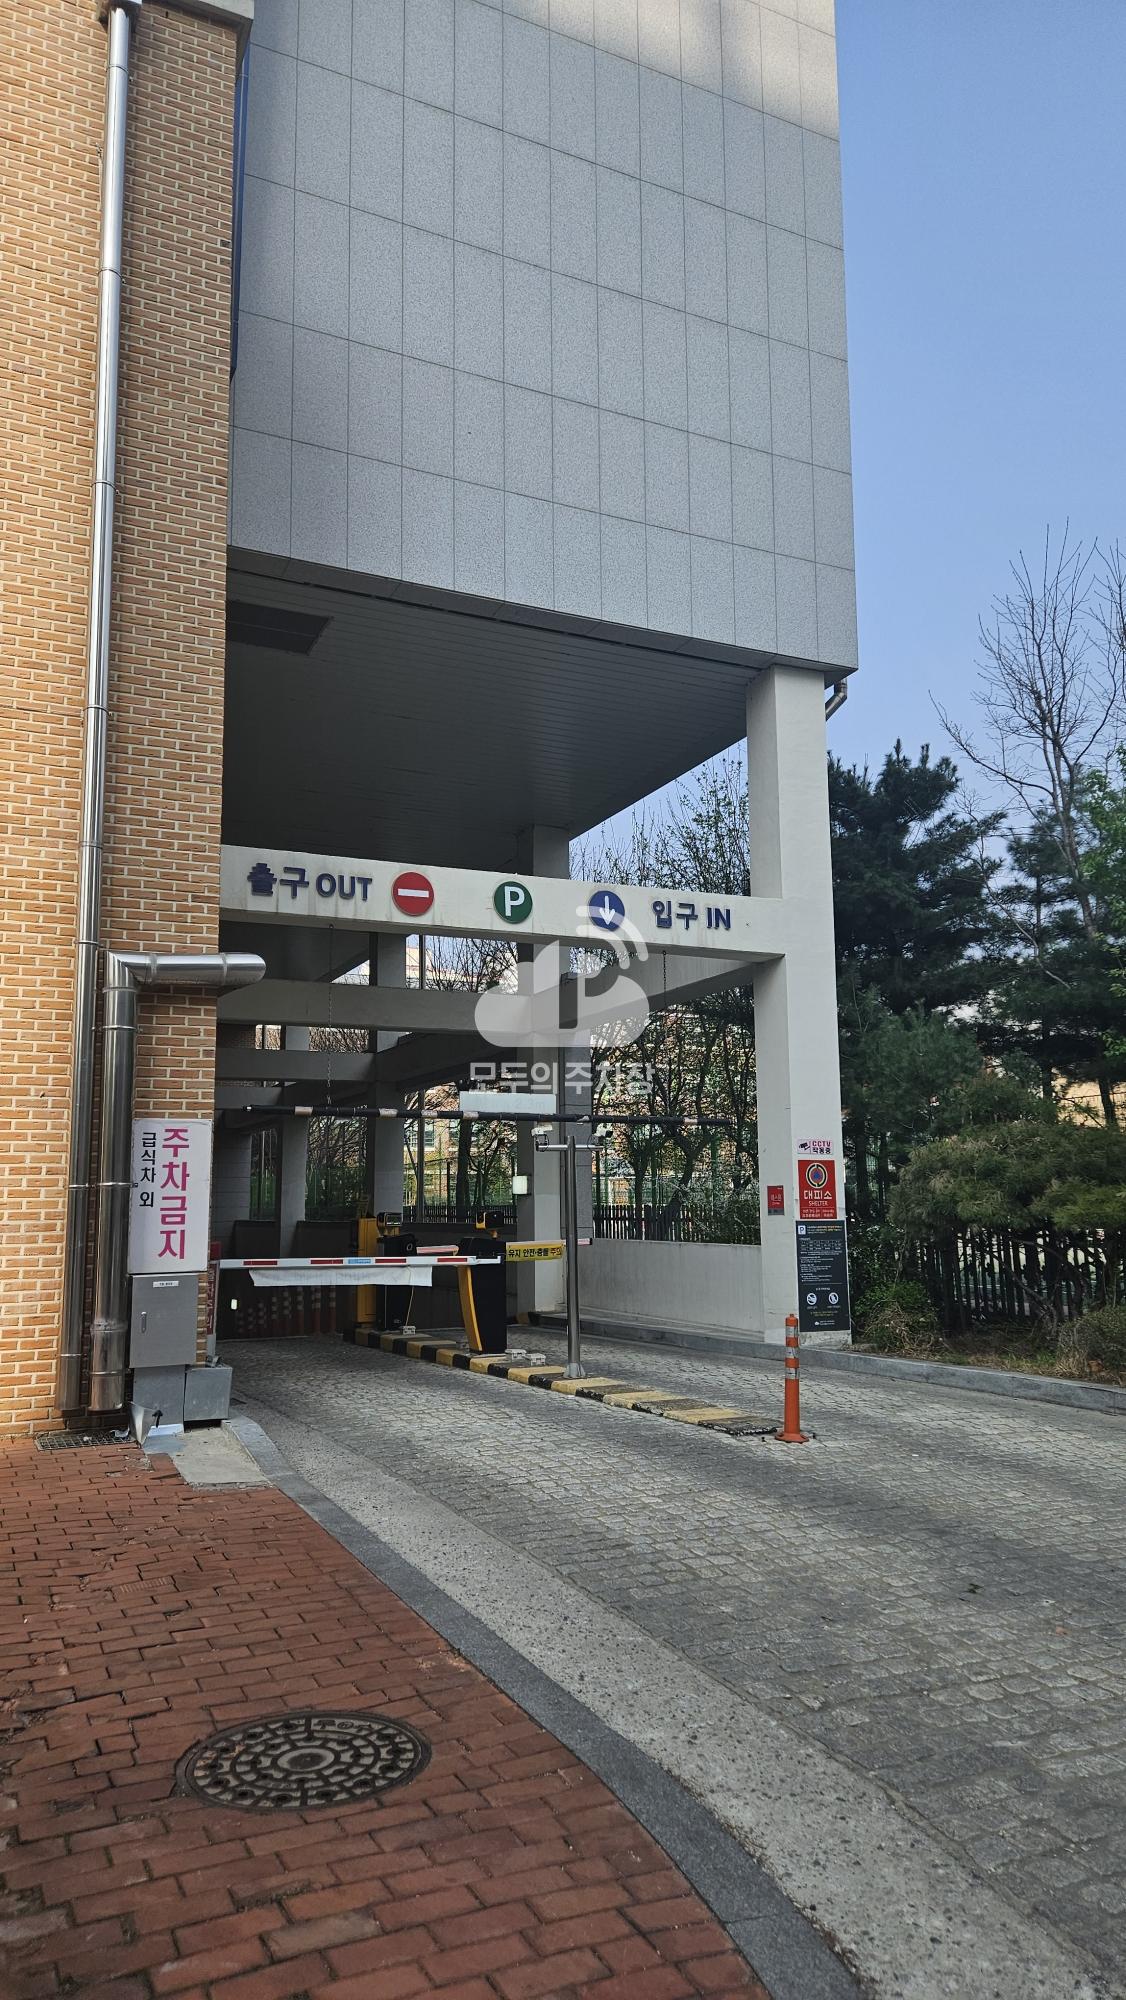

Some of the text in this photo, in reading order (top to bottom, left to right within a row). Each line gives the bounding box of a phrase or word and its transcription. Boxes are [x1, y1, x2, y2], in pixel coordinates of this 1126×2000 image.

[247, 863, 373, 902] 출구 OUT
[504, 886, 525, 917] P
[652, 900, 731, 930] 입구 IN
[139, 1132, 157, 1208] 급식차 외
[158, 1128, 190, 1259] 주차금지
[803, 1190, 832, 1200] 대피소
